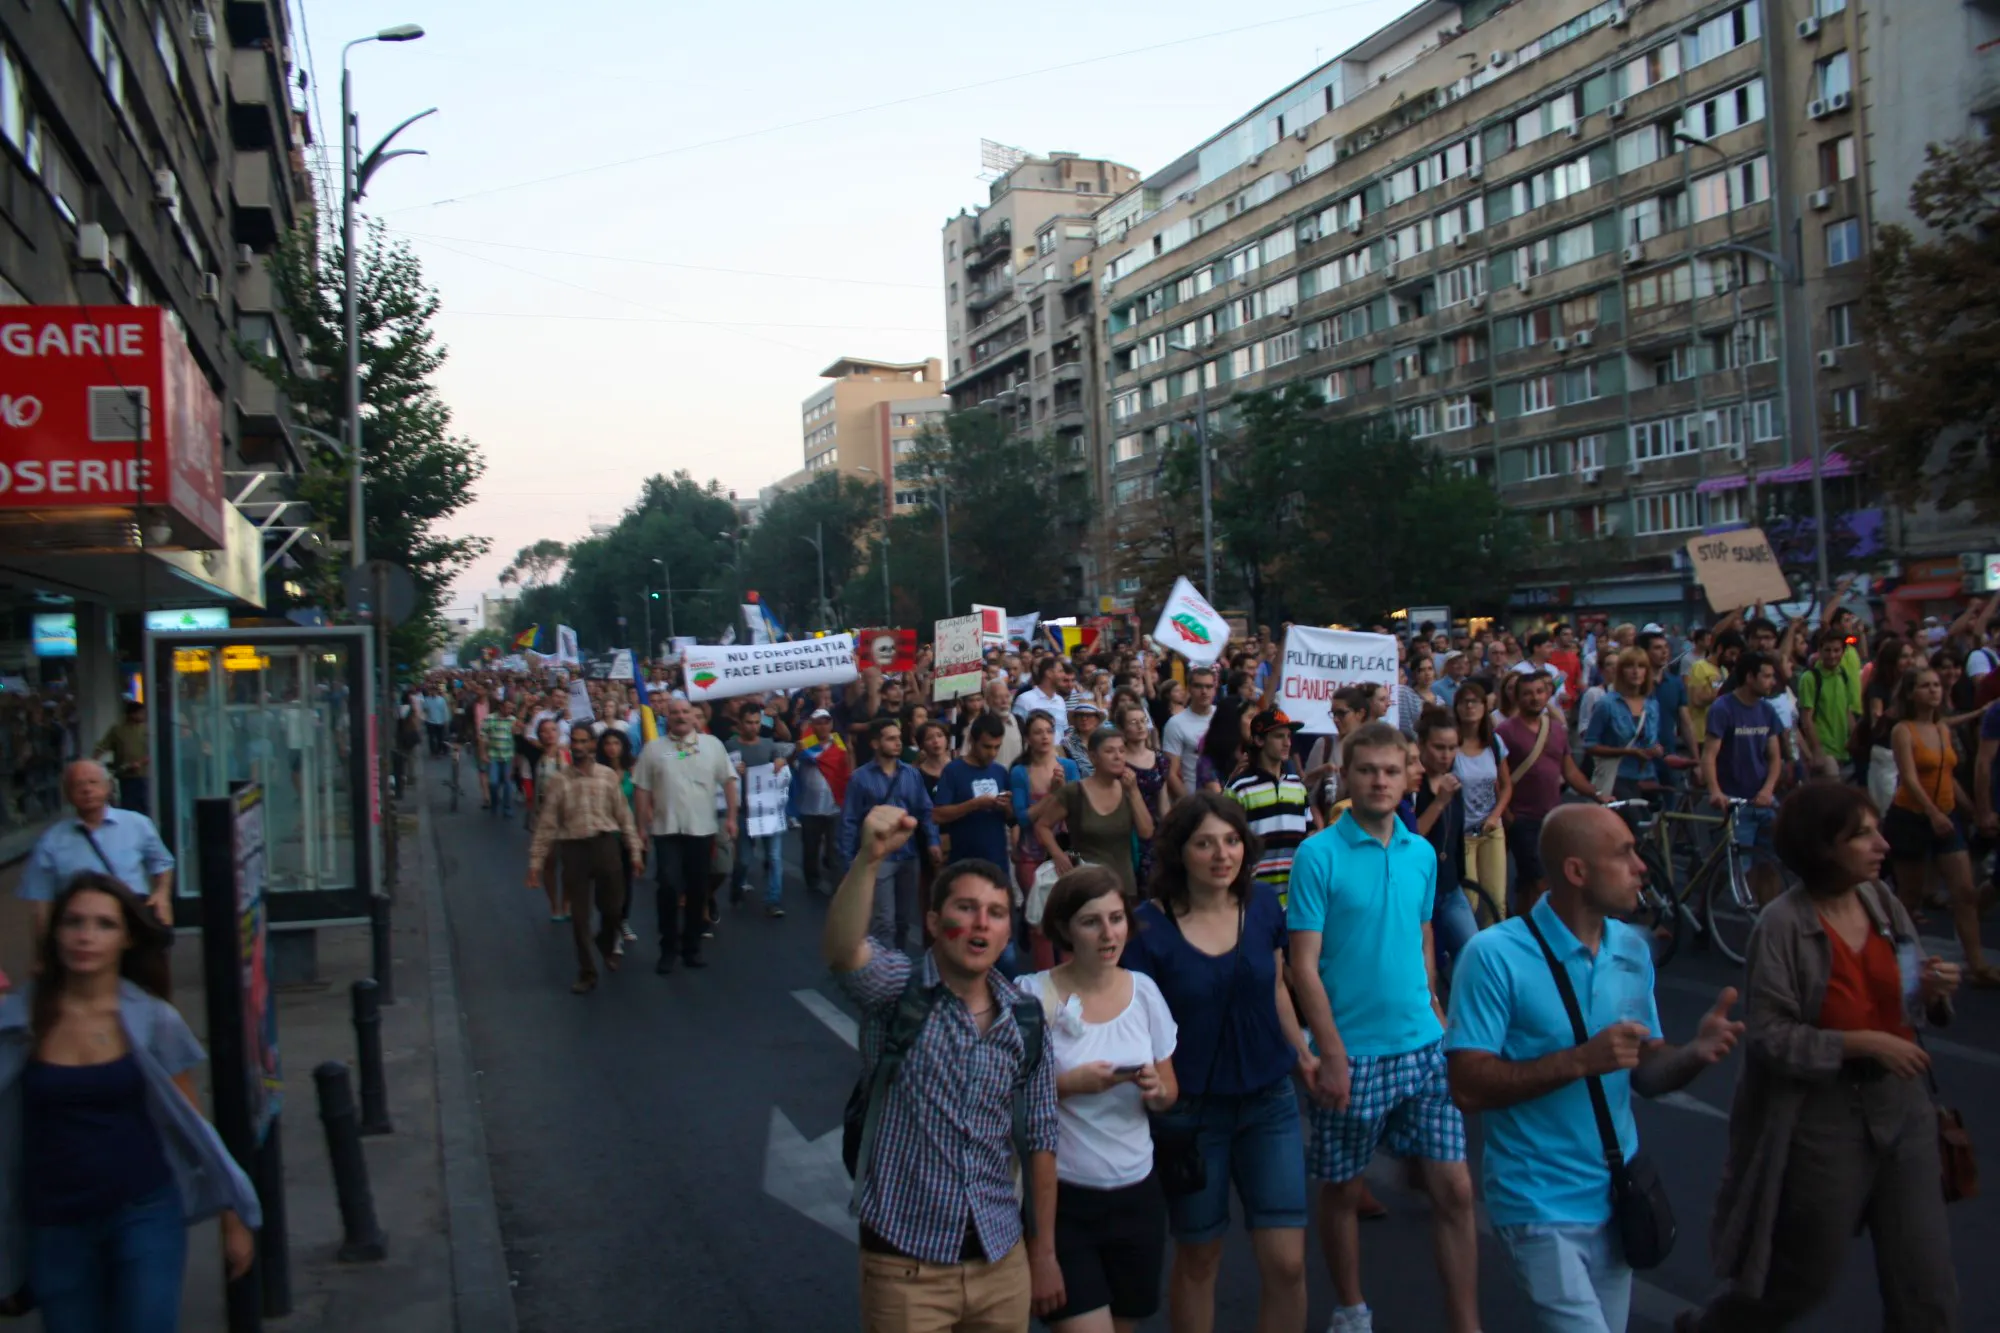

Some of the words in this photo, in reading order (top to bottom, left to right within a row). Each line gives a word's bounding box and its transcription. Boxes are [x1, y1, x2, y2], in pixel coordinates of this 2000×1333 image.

[1698, 541, 1728, 563] STOP
[727, 651, 749, 663] NU
[724, 663, 762, 679] FACE
